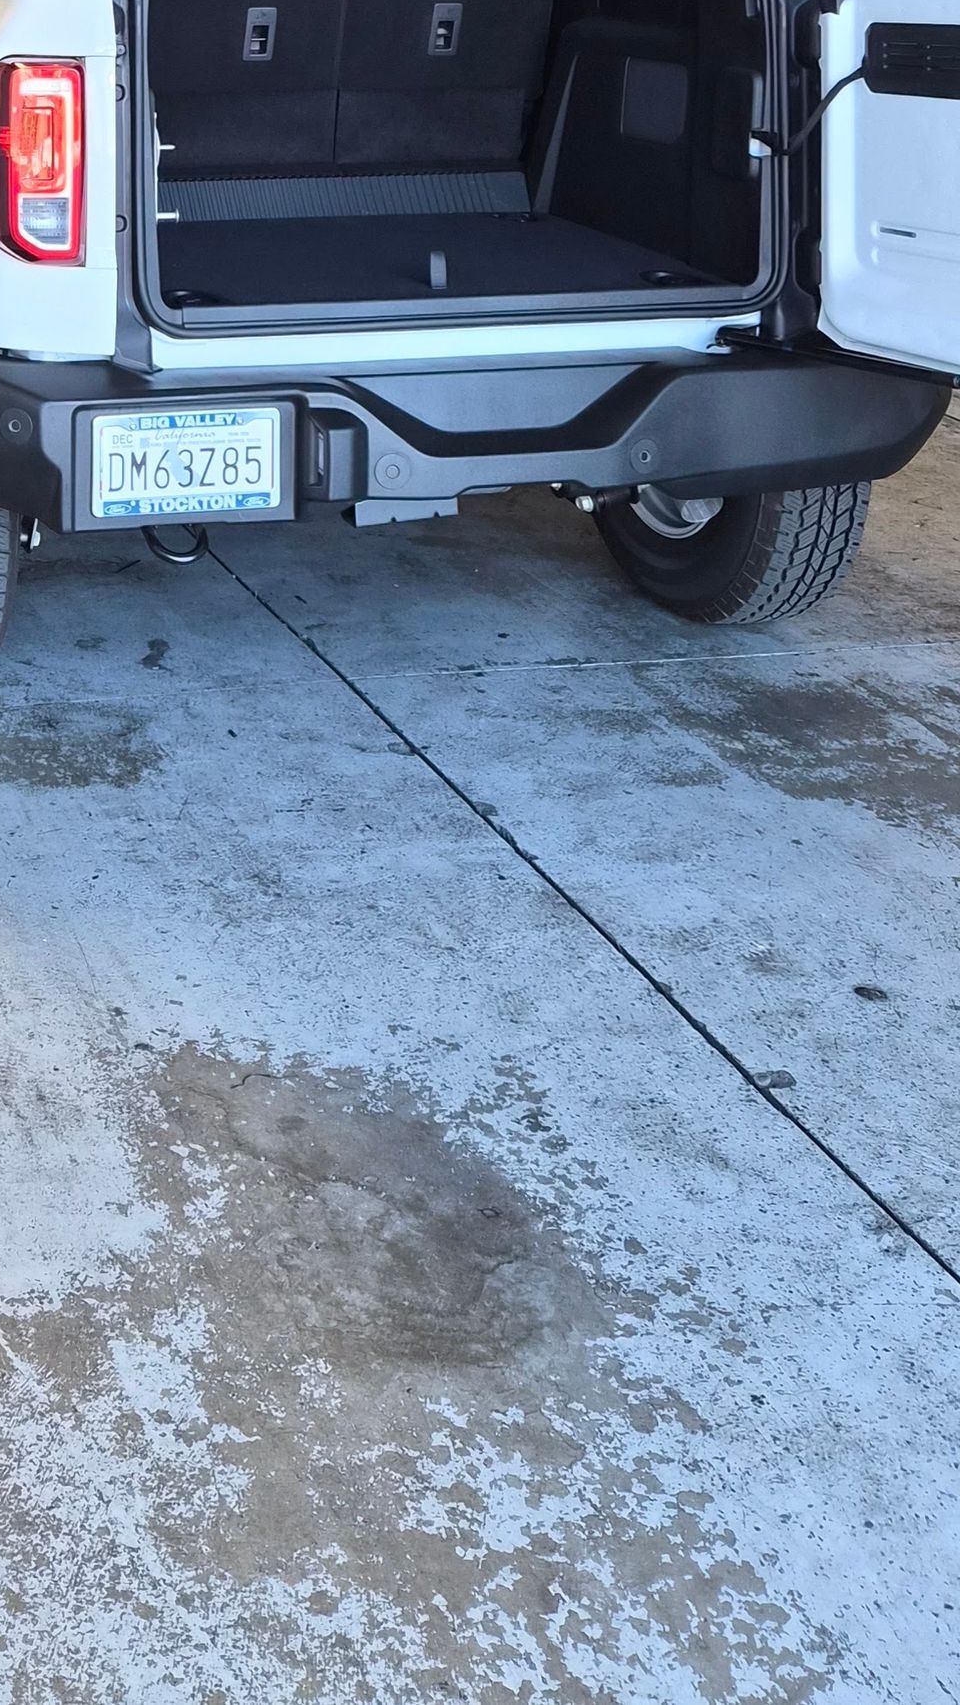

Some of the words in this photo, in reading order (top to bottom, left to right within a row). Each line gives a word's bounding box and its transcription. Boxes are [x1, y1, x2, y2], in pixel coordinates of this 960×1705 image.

[140, 416, 170, 430] BIG
[175, 413, 237, 427] VALLEY
[112, 434, 133, 445] DEC
[108, 447, 262, 492] DM63Z85
[139, 494, 237, 513] STOCKTON
